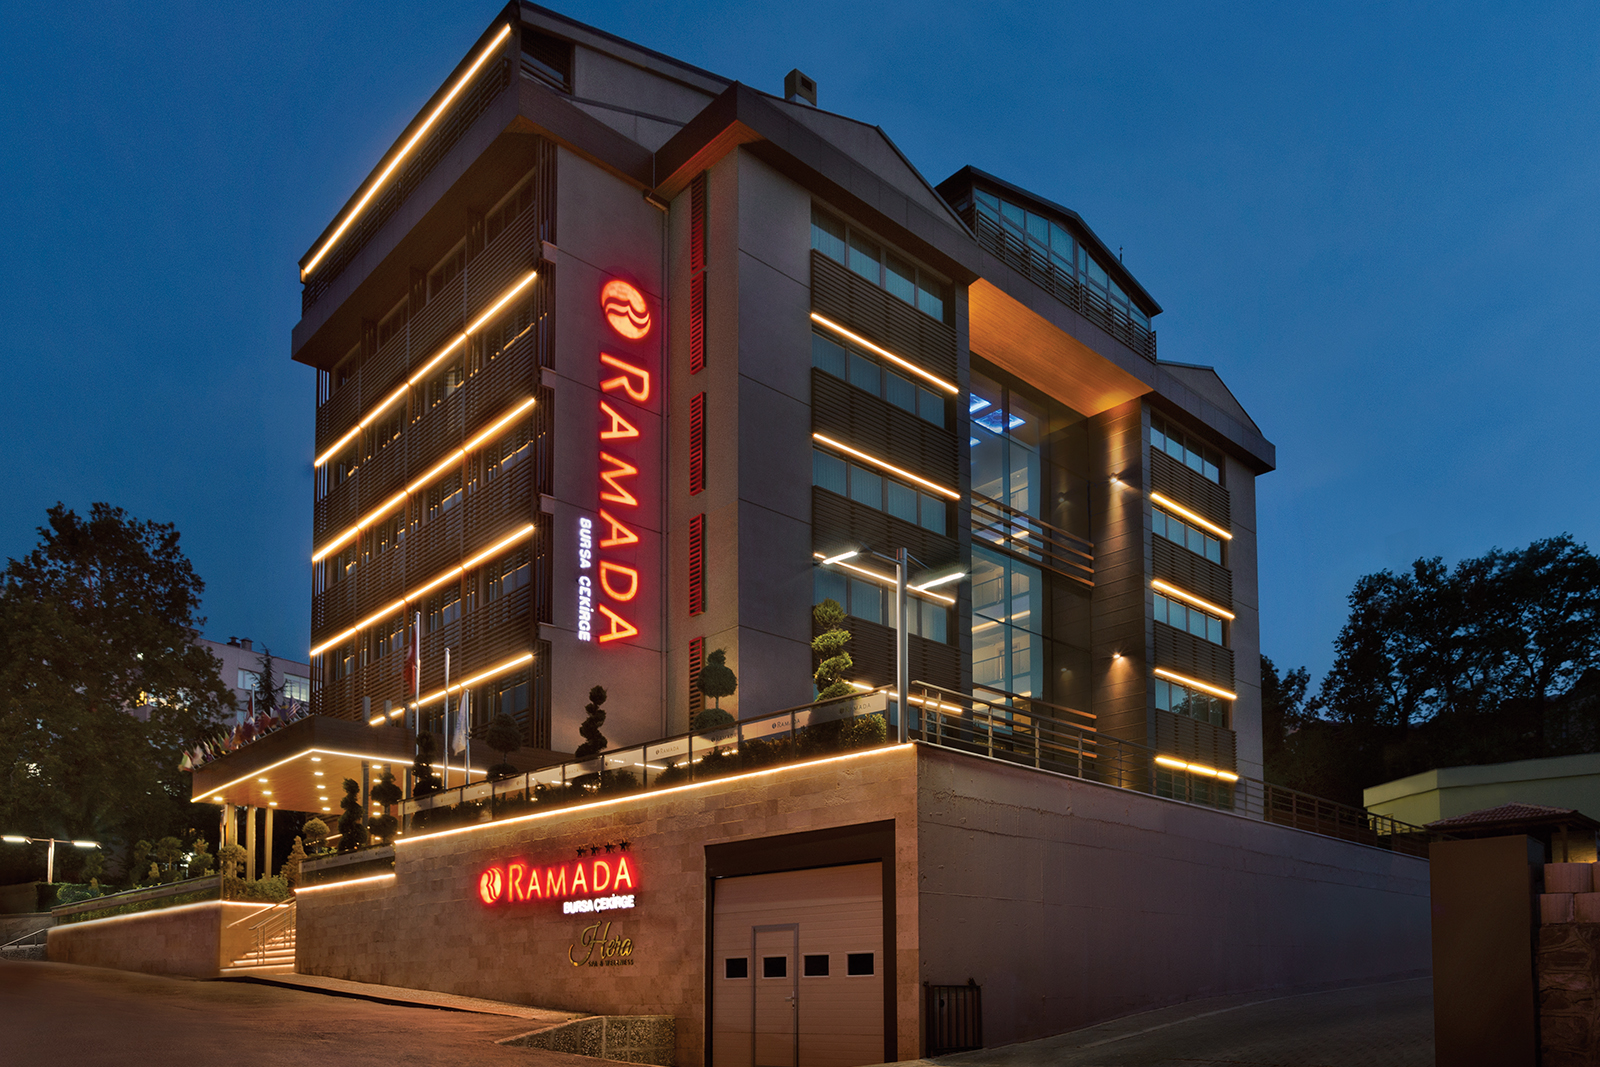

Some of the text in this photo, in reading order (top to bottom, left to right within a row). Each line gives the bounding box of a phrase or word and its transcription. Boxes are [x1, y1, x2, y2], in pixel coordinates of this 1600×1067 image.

[600, 352, 650, 642] RAMADA
[579, 516, 592, 569] BURSA
[508, 856, 633, 902] RAMADA
[563, 899, 594, 914] BURSA
